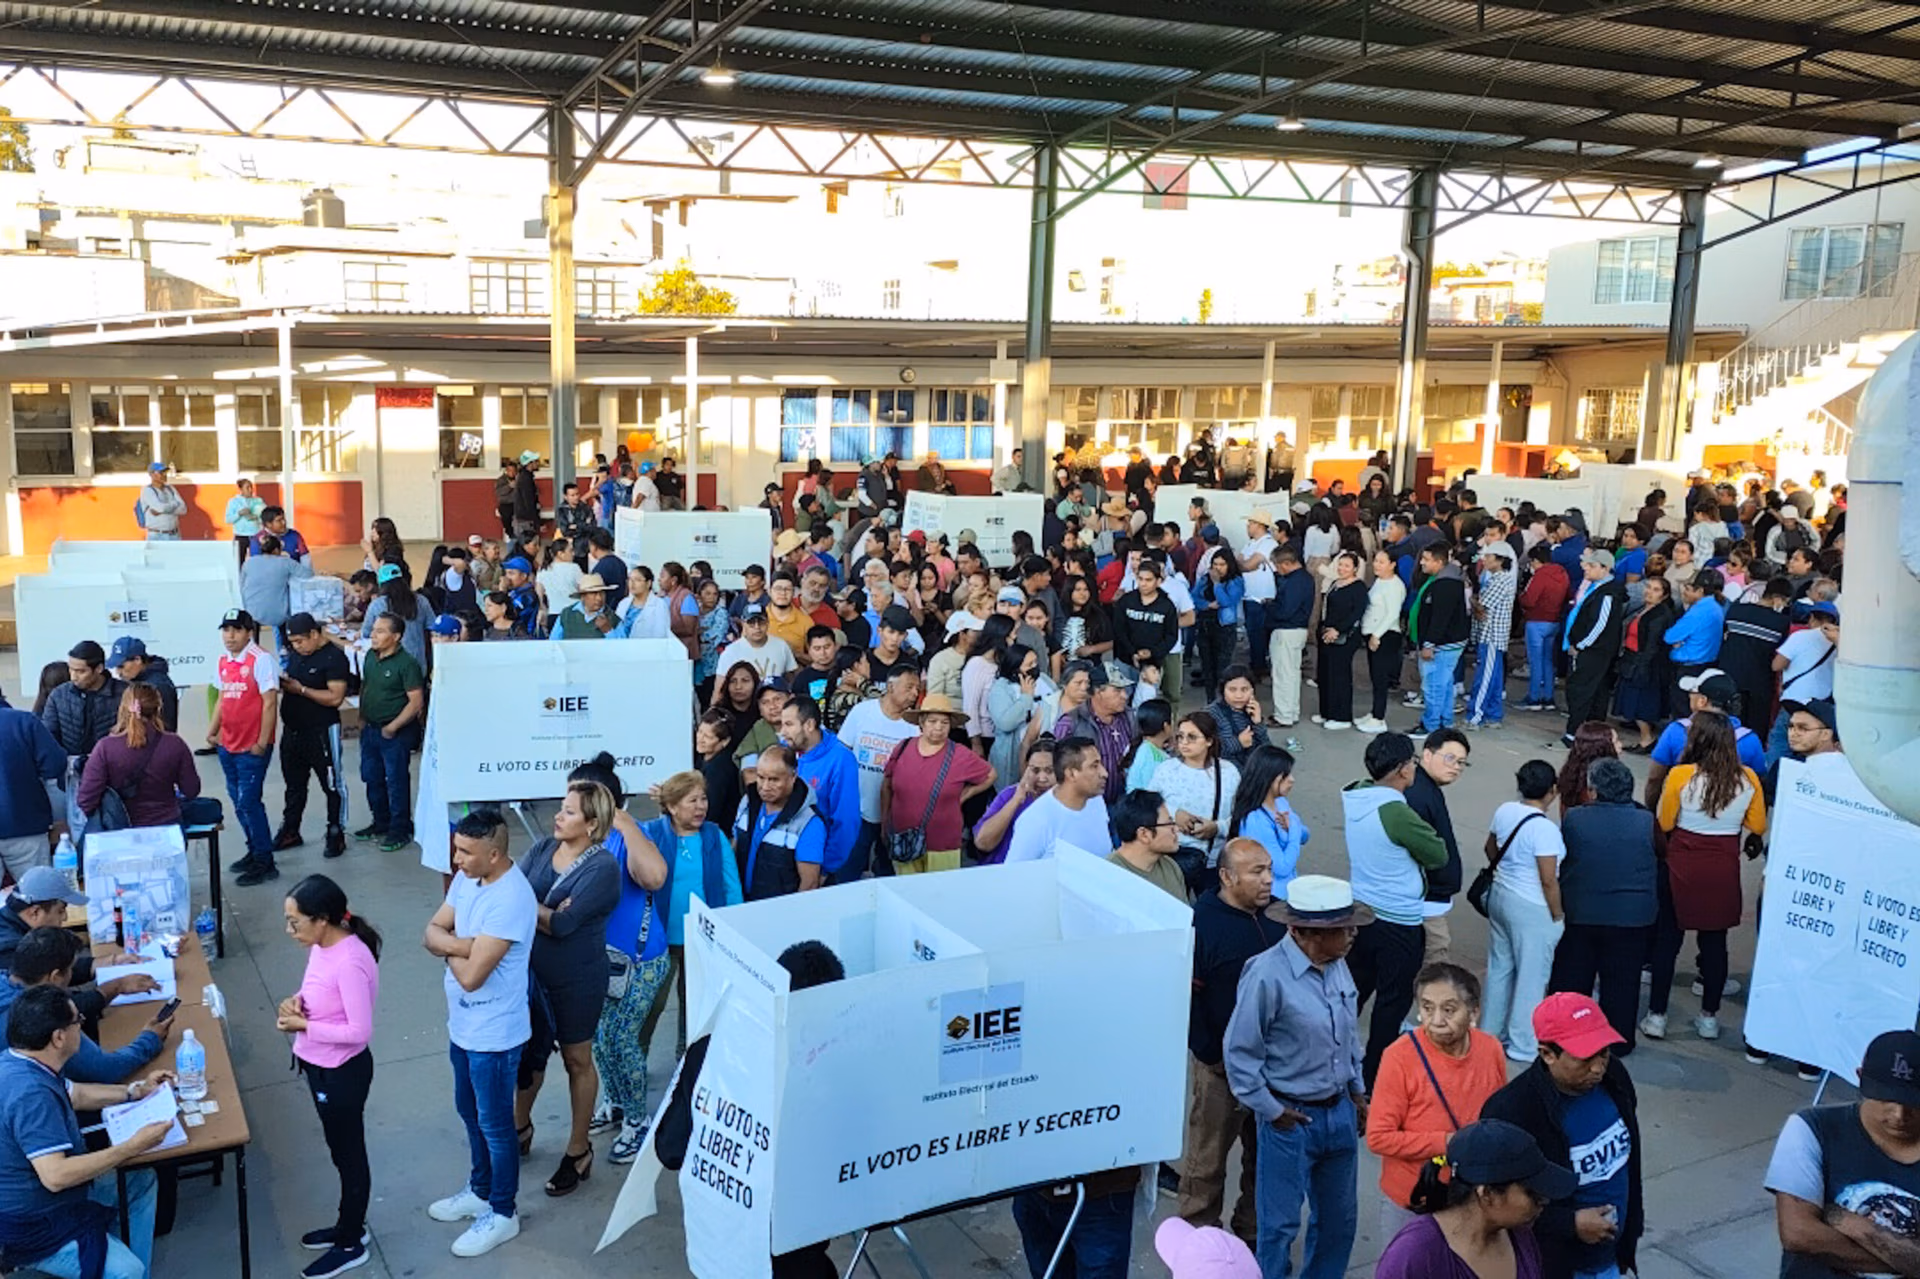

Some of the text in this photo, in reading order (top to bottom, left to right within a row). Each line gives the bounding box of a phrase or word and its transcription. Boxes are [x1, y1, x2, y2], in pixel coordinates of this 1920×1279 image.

[123, 610, 149, 623] IEE
[167, 655, 205, 666] CRETO
[560, 696, 589, 712] IEE
[478, 762, 491, 773] EL
[497, 760, 531, 772] VOTO
[535, 760, 548, 771] ES
[615, 755, 655, 767] CRETO
[1785, 864, 1846, 895] EL VOTO ES
[1792, 889, 1835, 913] LIBRE Y
[1863, 889, 1920, 922] EL VOTO ES
[1786, 912, 1835, 938] SECRETO
[1868, 916, 1909, 943] LIBRE Y
[1861, 938, 1907, 968] SECRETO
[973, 1006, 1021, 1039] IEE
[1891, 1052, 1914, 1080] LA
[922, 1089, 957, 1103] Instituto
[997, 1079, 1008, 1089] del
[1011, 1073, 1039, 1086] Estado
[694, 1086, 770, 1151] EL VOTO ES
[699, 1124, 755, 1175] LIBRE Y
[838, 1104, 1120, 1183] EL VOTO ES LIBRE Y SECRETO
[691, 1153, 753, 1209] SECRETO
